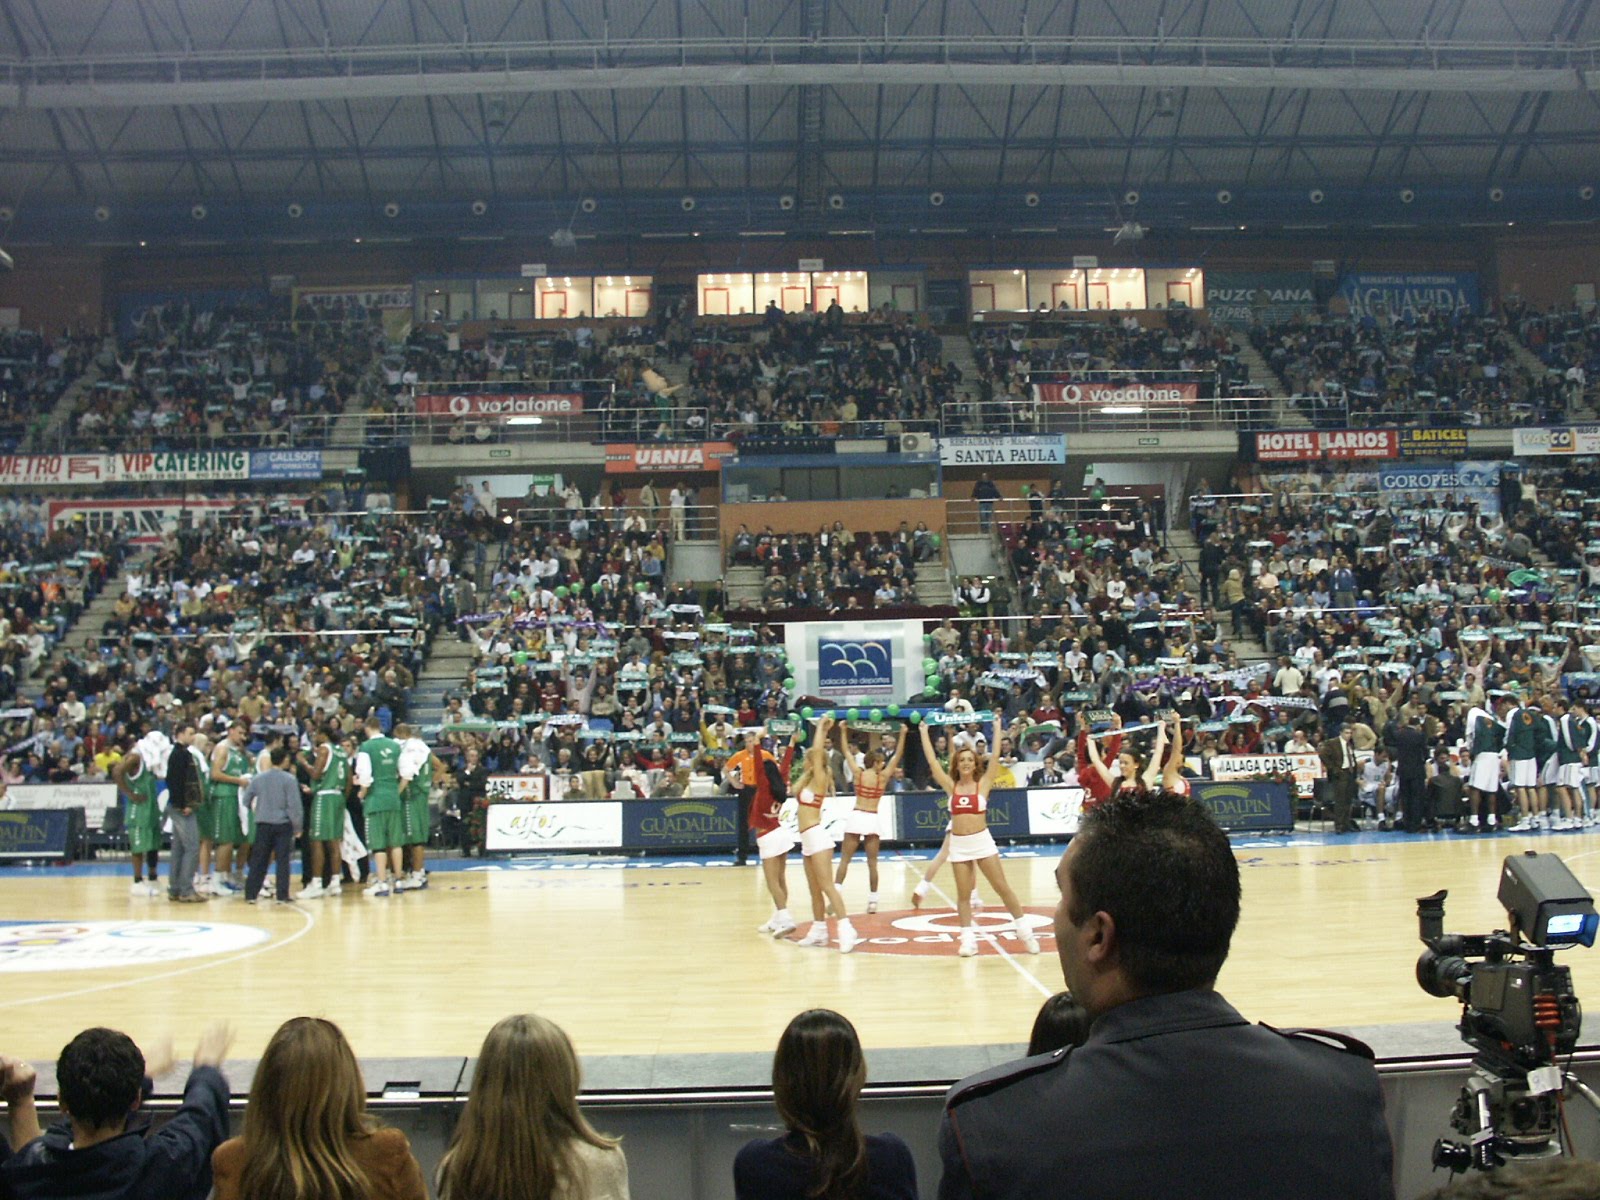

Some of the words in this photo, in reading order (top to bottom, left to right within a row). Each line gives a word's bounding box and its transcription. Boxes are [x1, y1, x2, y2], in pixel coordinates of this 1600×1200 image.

[1089, 385, 1181, 402] vodafone
[478, 397, 572, 412] vodafone
[1258, 433, 1313, 450] HOTEL
[1326, 431, 1389, 448] LARIOS
[1412, 429, 1467, 440] BATICEL
[1521, 432, 1570, 445] VASCO
[269, 451, 320, 461] CALLSOFT
[636, 449, 704, 465] URNIA
[955, 449, 1005, 463] SANTA
[1010, 449, 1057, 462] PAULA
[1217, 760, 1261, 773] MALAGA
[1264, 758, 1293, 772] CASH
[485, 780, 514, 794] CASH
